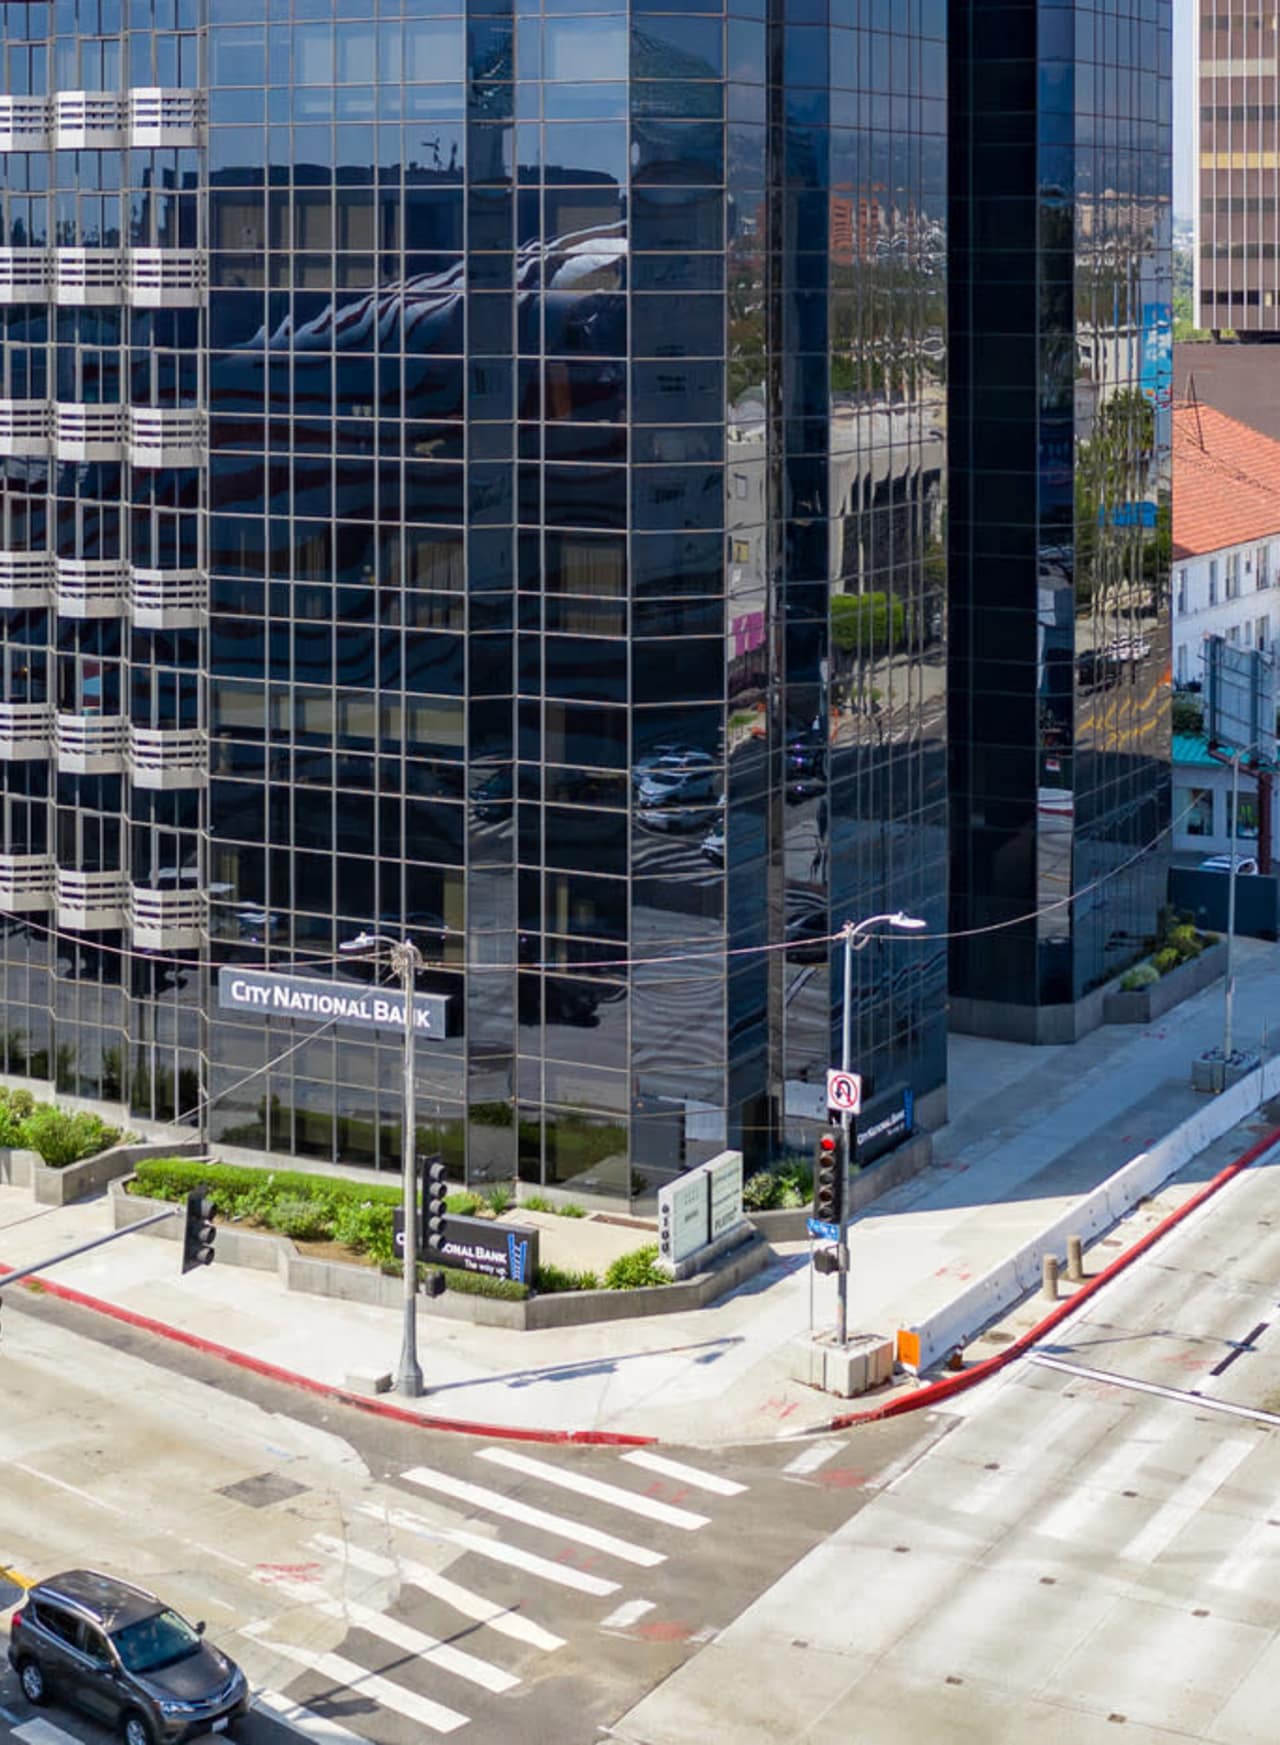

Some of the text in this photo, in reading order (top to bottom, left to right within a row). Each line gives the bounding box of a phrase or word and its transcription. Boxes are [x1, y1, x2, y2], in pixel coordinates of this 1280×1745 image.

[231, 981, 272, 1004] CITY
[273, 987, 369, 1019] NATIONAL
[475, 1246, 508, 1265] BANK
